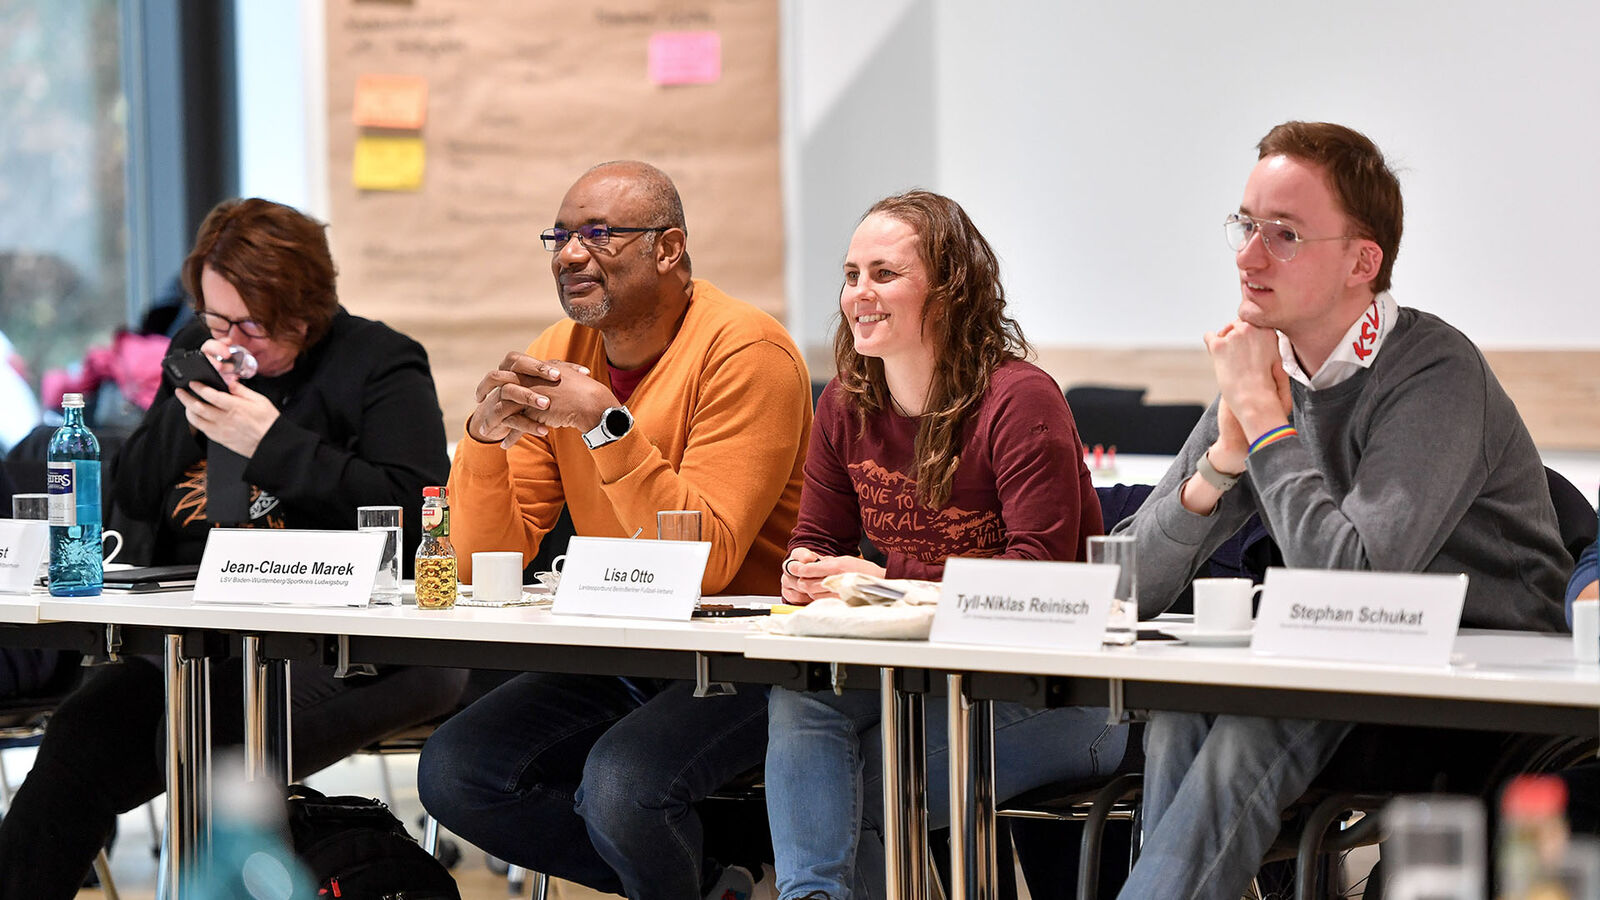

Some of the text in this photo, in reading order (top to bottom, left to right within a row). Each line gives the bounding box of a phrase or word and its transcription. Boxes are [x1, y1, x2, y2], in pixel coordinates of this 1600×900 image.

[1353, 300, 1379, 361] KSV
[895, 493, 914, 510] TO
[861, 505, 926, 532] ATURAL
[969, 517, 1001, 539] STAY
[221, 560, 355, 576] Jean-Claude Marek
[604, 567, 655, 584] Lisa Otto
[314, 579, 349, 587] Ludwigsburg
[957, 594, 1090, 615] Tyll-Niklas Reinisch
[1289, 602, 1424, 626] Stephan Schukat
